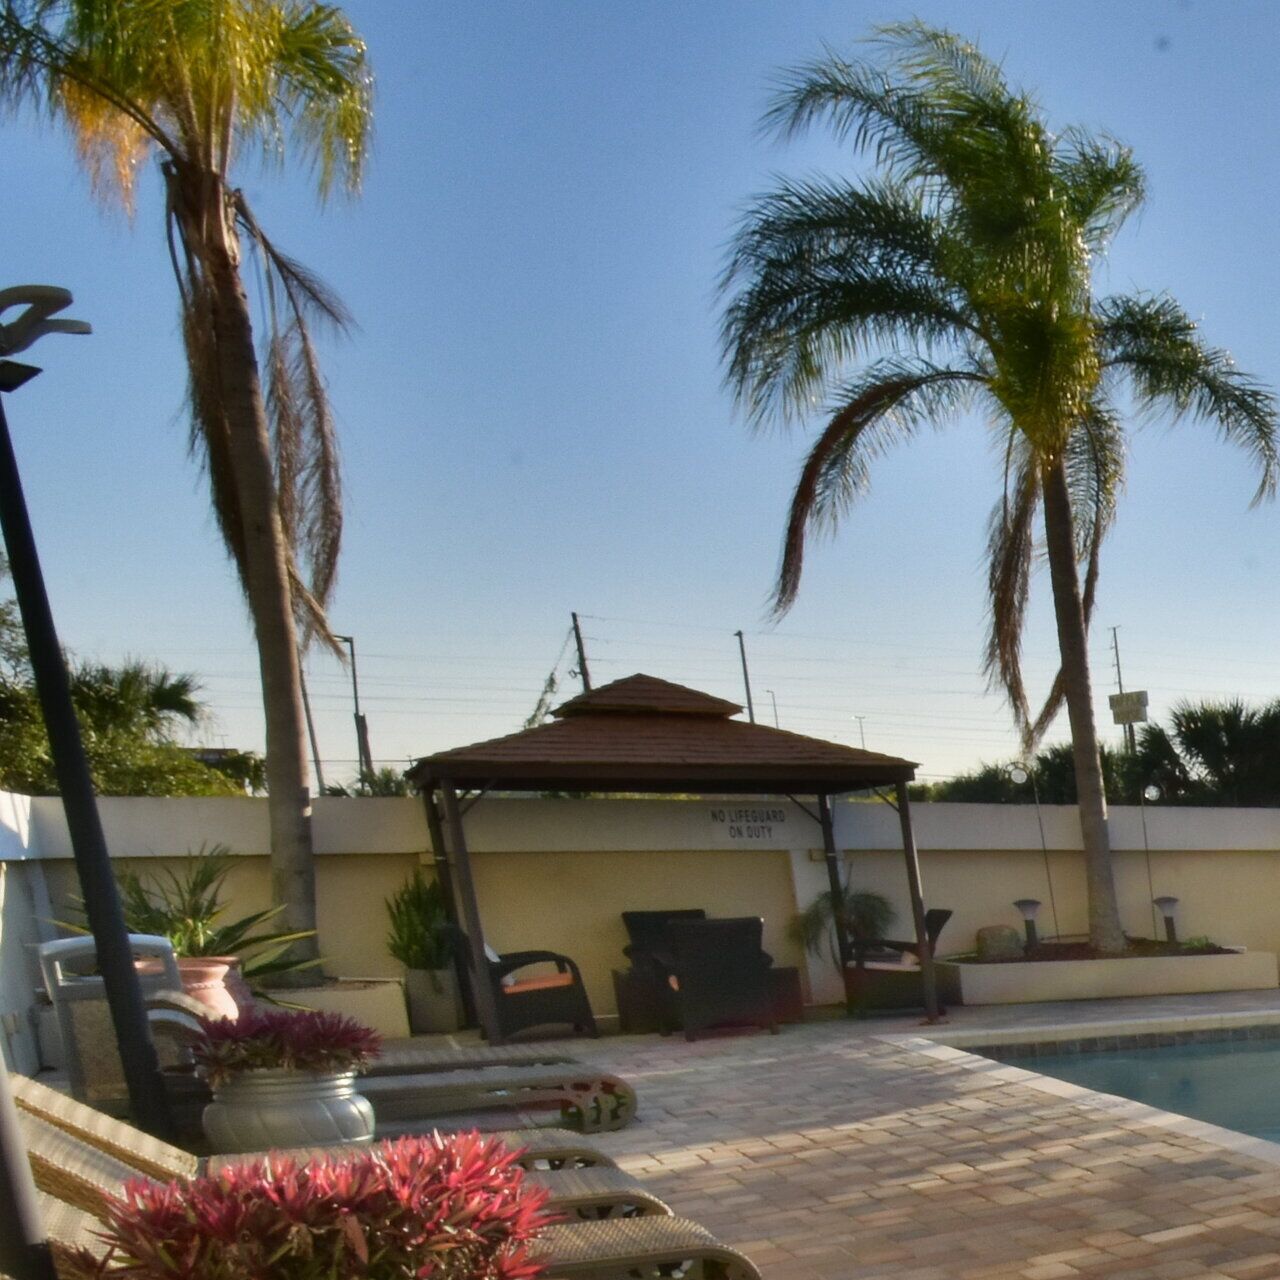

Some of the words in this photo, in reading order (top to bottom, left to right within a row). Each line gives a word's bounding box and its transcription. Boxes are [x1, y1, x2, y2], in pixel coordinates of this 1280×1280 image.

[710, 809, 726, 823] NO
[729, 809, 786, 823] LIFEGUARD
[729, 825, 743, 839] ON
[746, 825, 773, 839] DUTY
